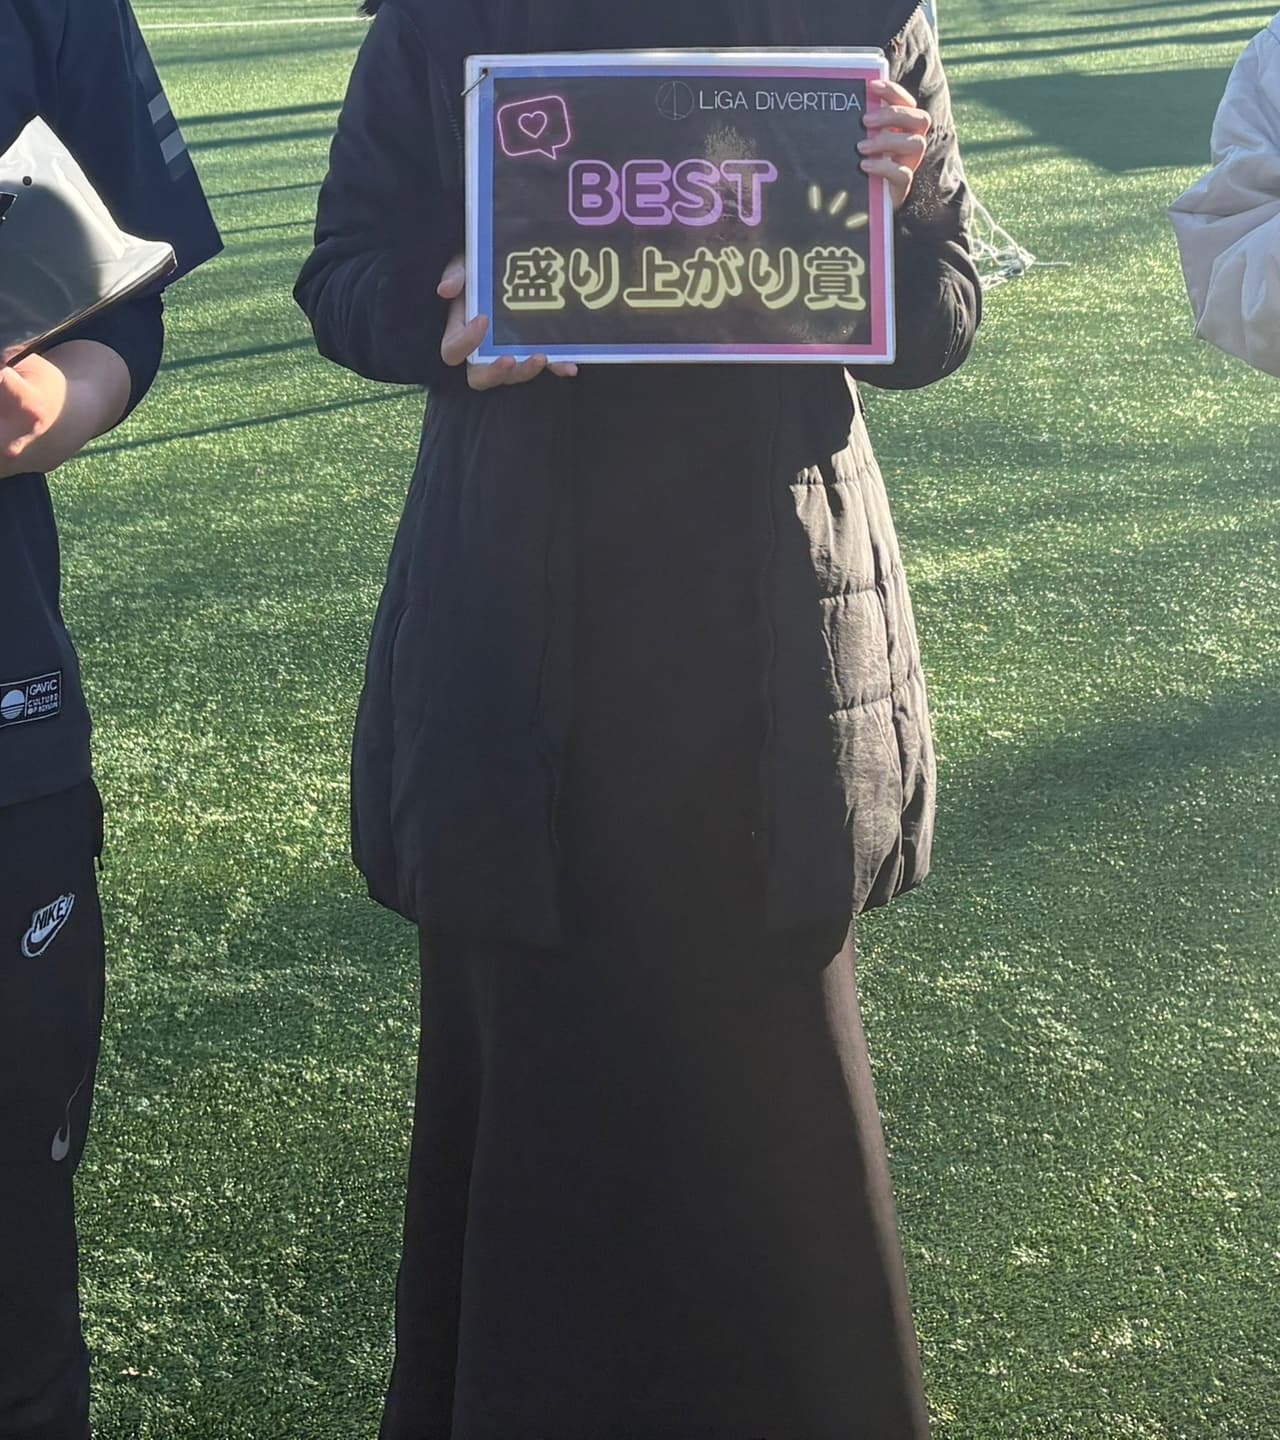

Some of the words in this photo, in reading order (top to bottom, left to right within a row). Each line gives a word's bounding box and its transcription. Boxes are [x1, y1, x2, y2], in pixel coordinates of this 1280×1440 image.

[568, 158, 778, 226] BEST
[503, 245, 866, 311] 盛り上がり賞
[33, 898, 66, 934] NIKE
